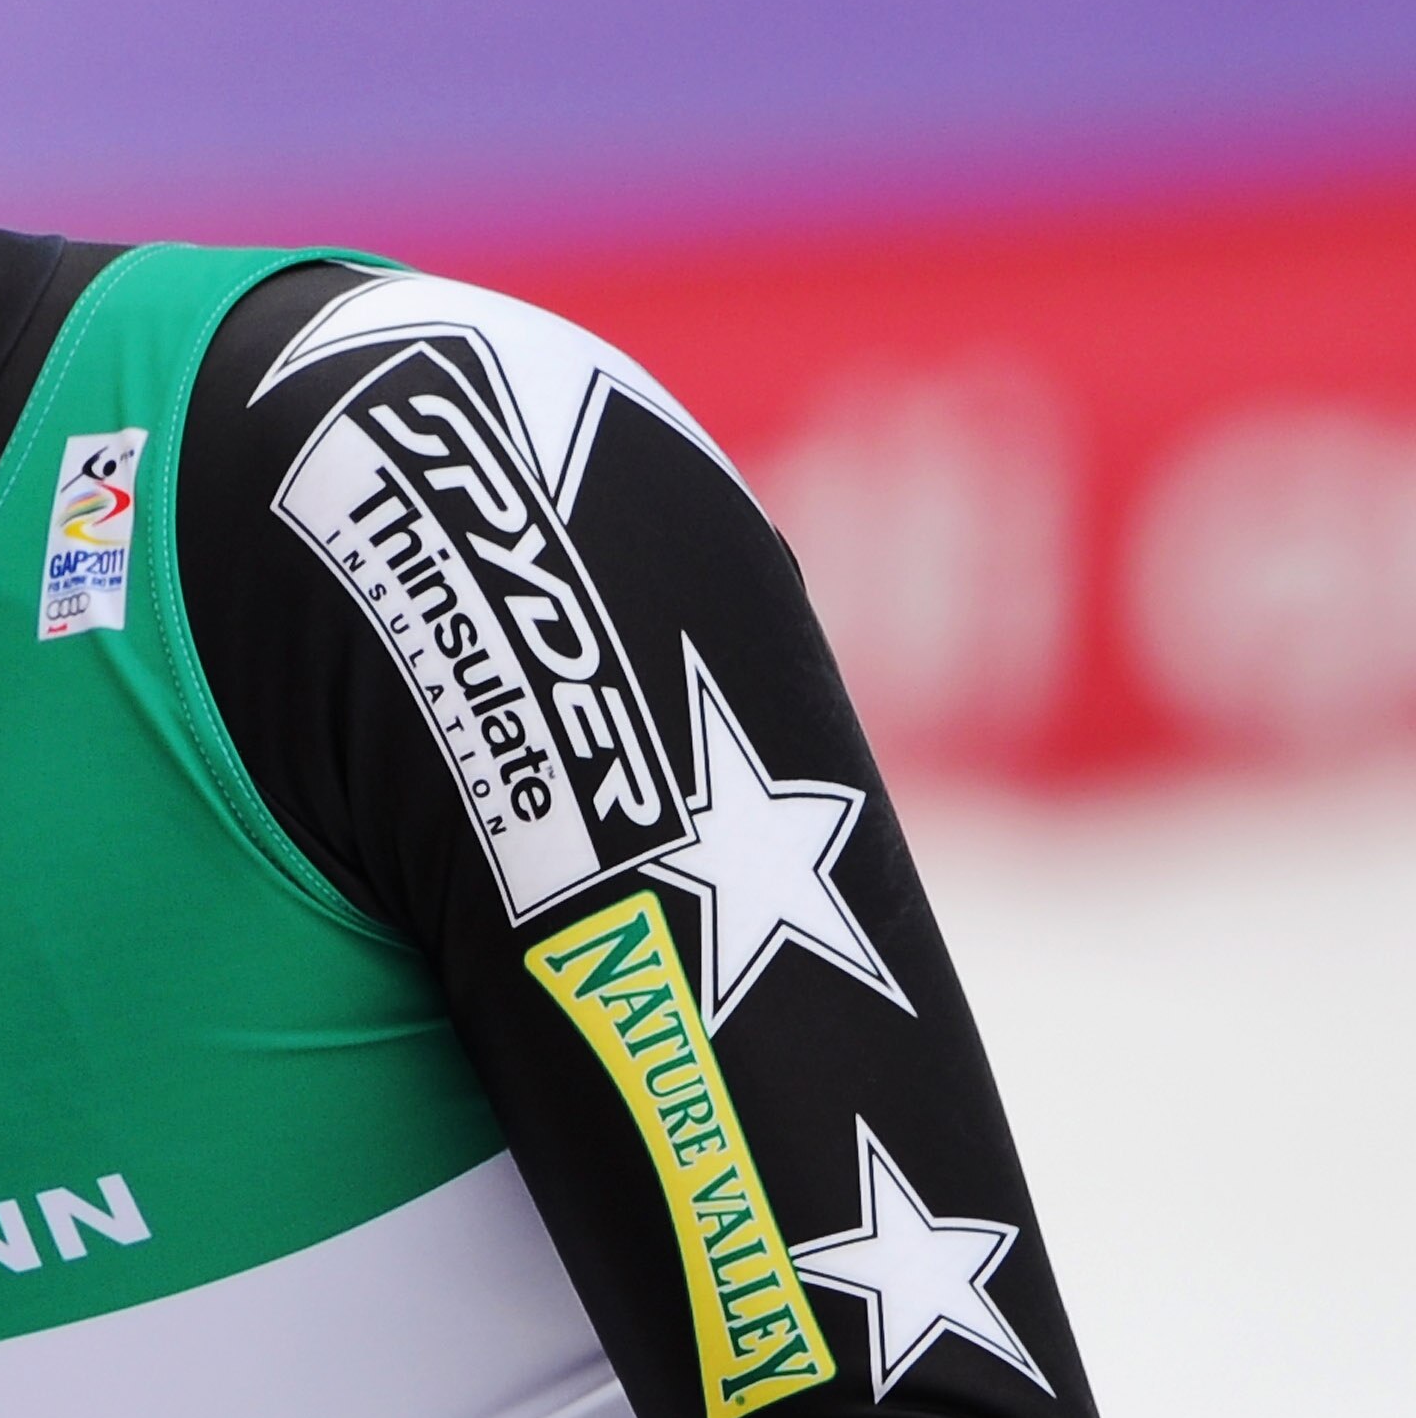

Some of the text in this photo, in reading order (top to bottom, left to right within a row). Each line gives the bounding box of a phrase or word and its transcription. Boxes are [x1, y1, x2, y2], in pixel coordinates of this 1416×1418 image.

[324, 528, 508, 837] INSULATION
[345, 465, 552, 823] Thinsulate
[367, 393, 661, 827] SPYDER
[544, 910, 819, 1403] NATURE VALLEY
